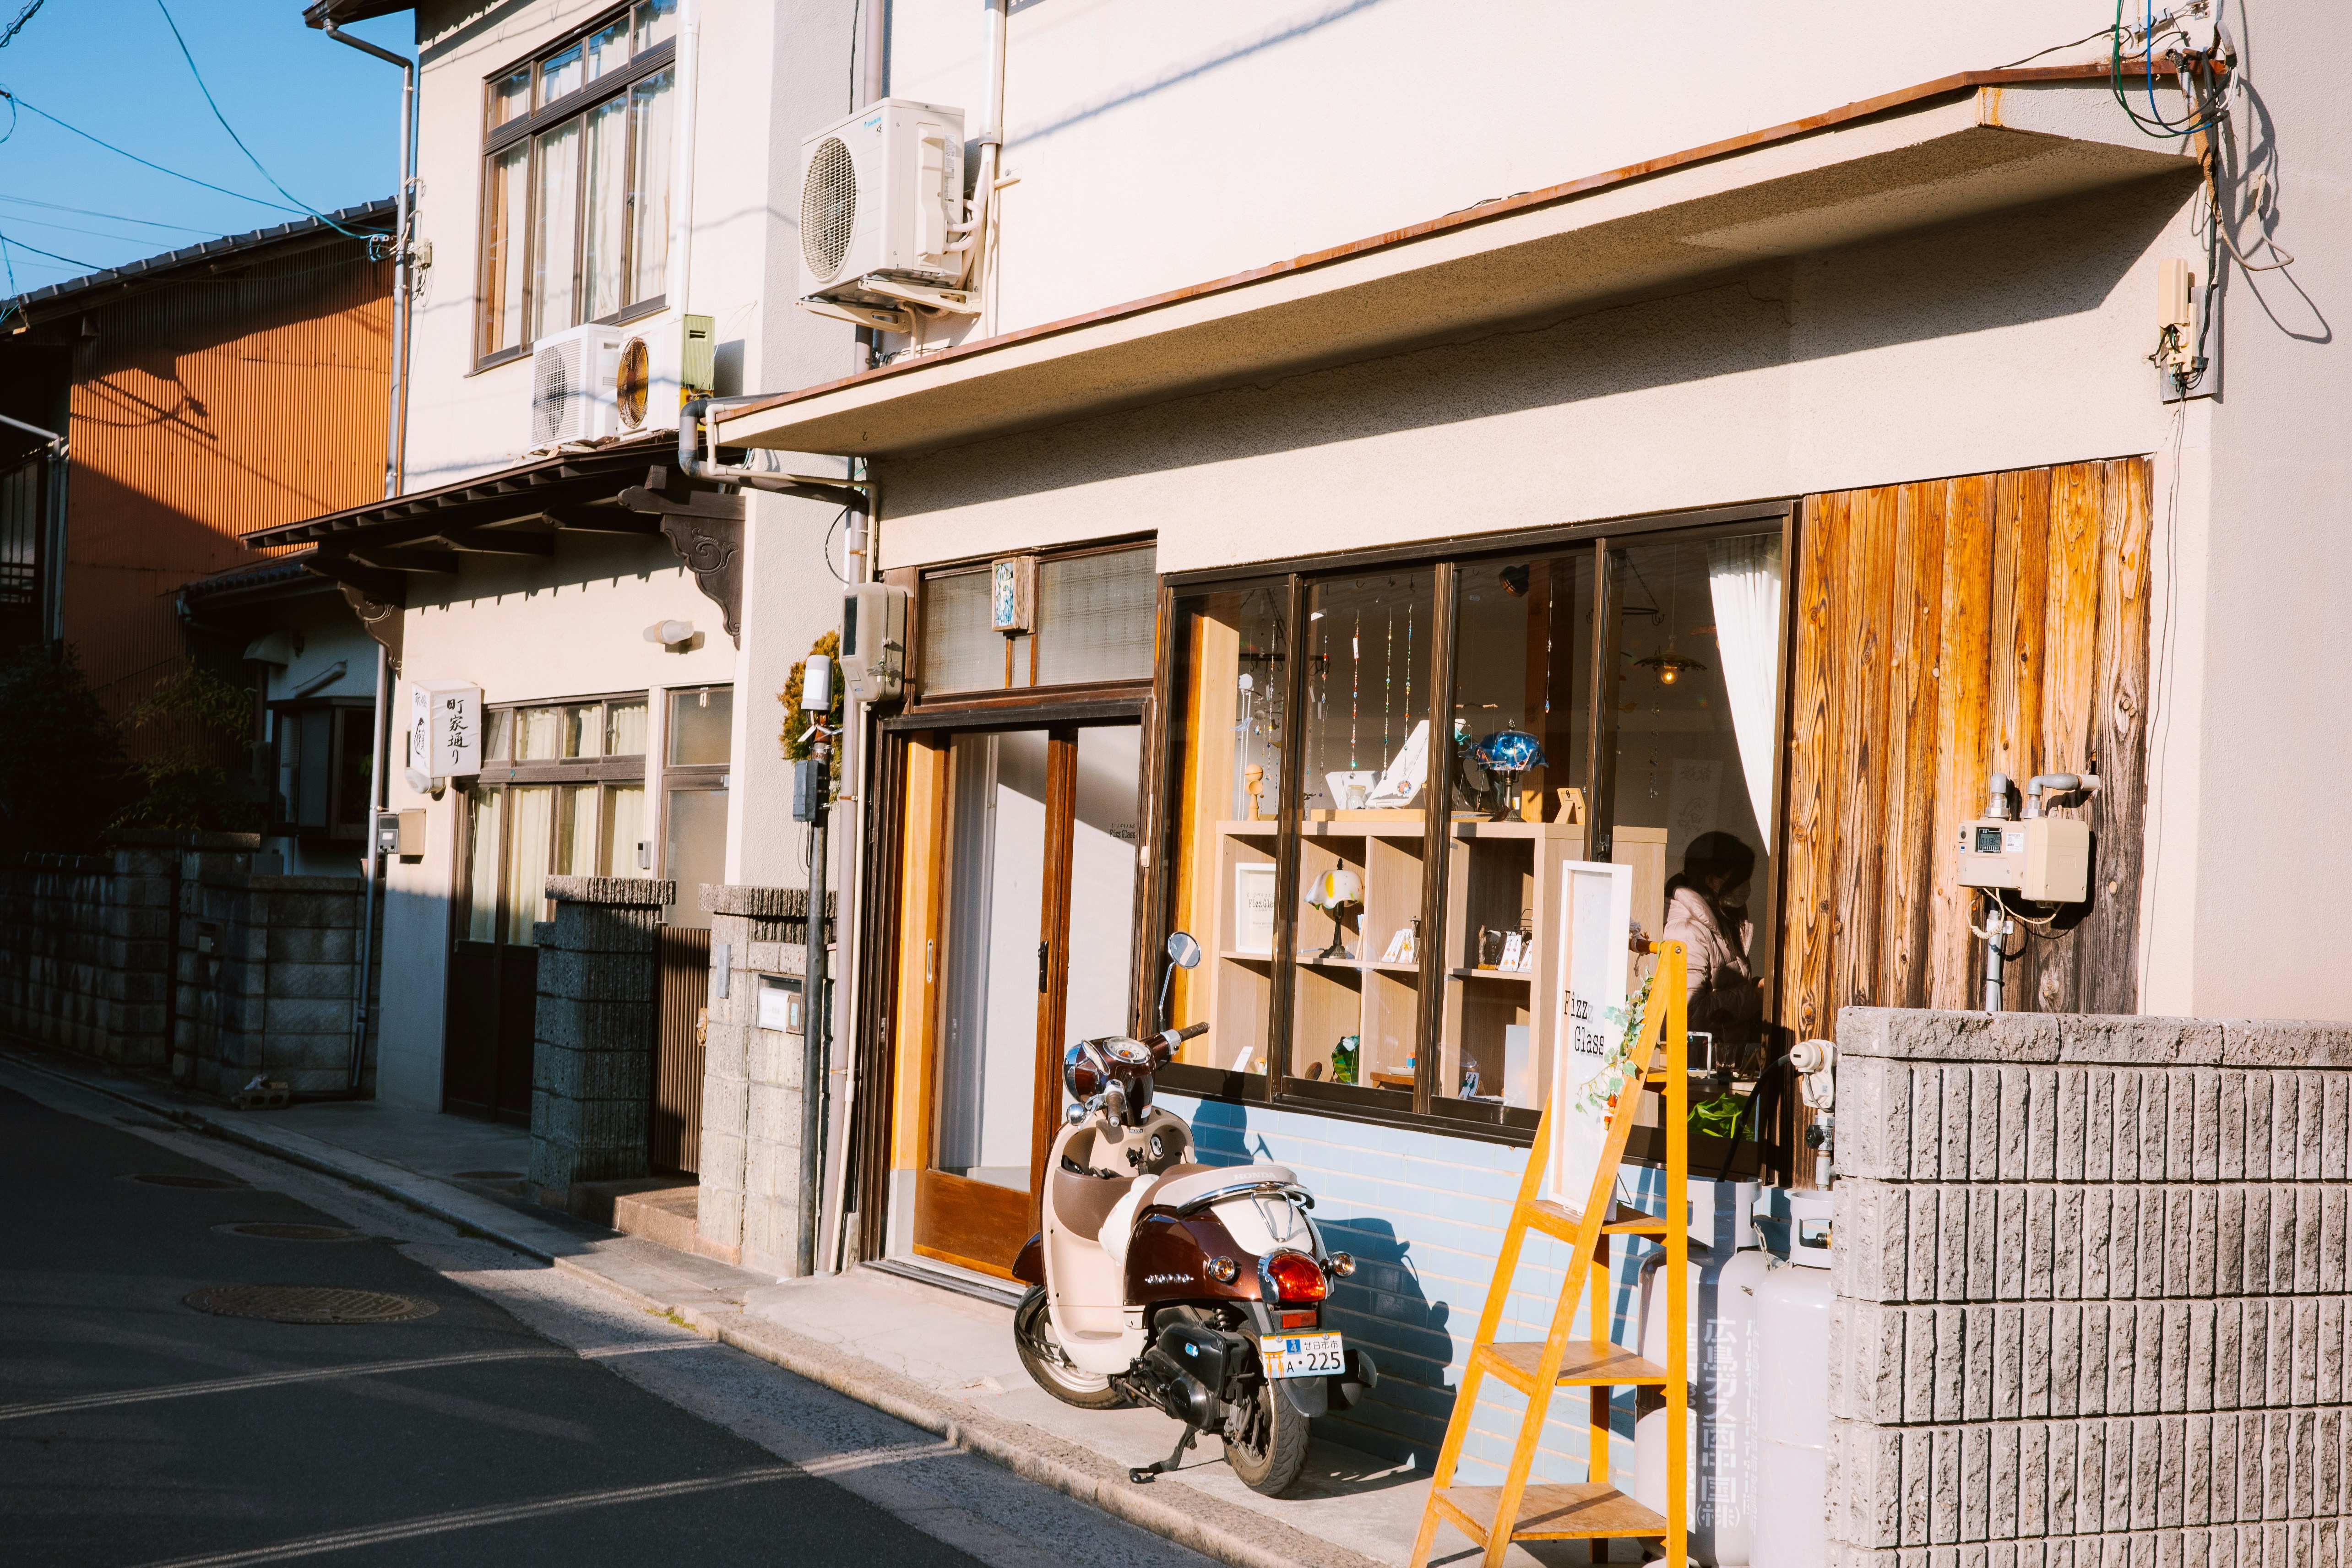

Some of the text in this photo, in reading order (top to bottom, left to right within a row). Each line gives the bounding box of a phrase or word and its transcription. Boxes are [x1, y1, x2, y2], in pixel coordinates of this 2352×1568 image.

[447, 699, 468, 765] 町家通り
[1110, 829, 1135, 839] Fizz Glass
[1249, 899, 1274, 908] Fizz Gla
[1564, 990, 1588, 1020] Fizz
[1575, 1025, 1604, 1055] Glass
[1233, 1172, 1277, 1181] HONDA
[1304, 1340, 1338, 1351] 廿日市市
[1287, 1361, 1294, 1373] A
